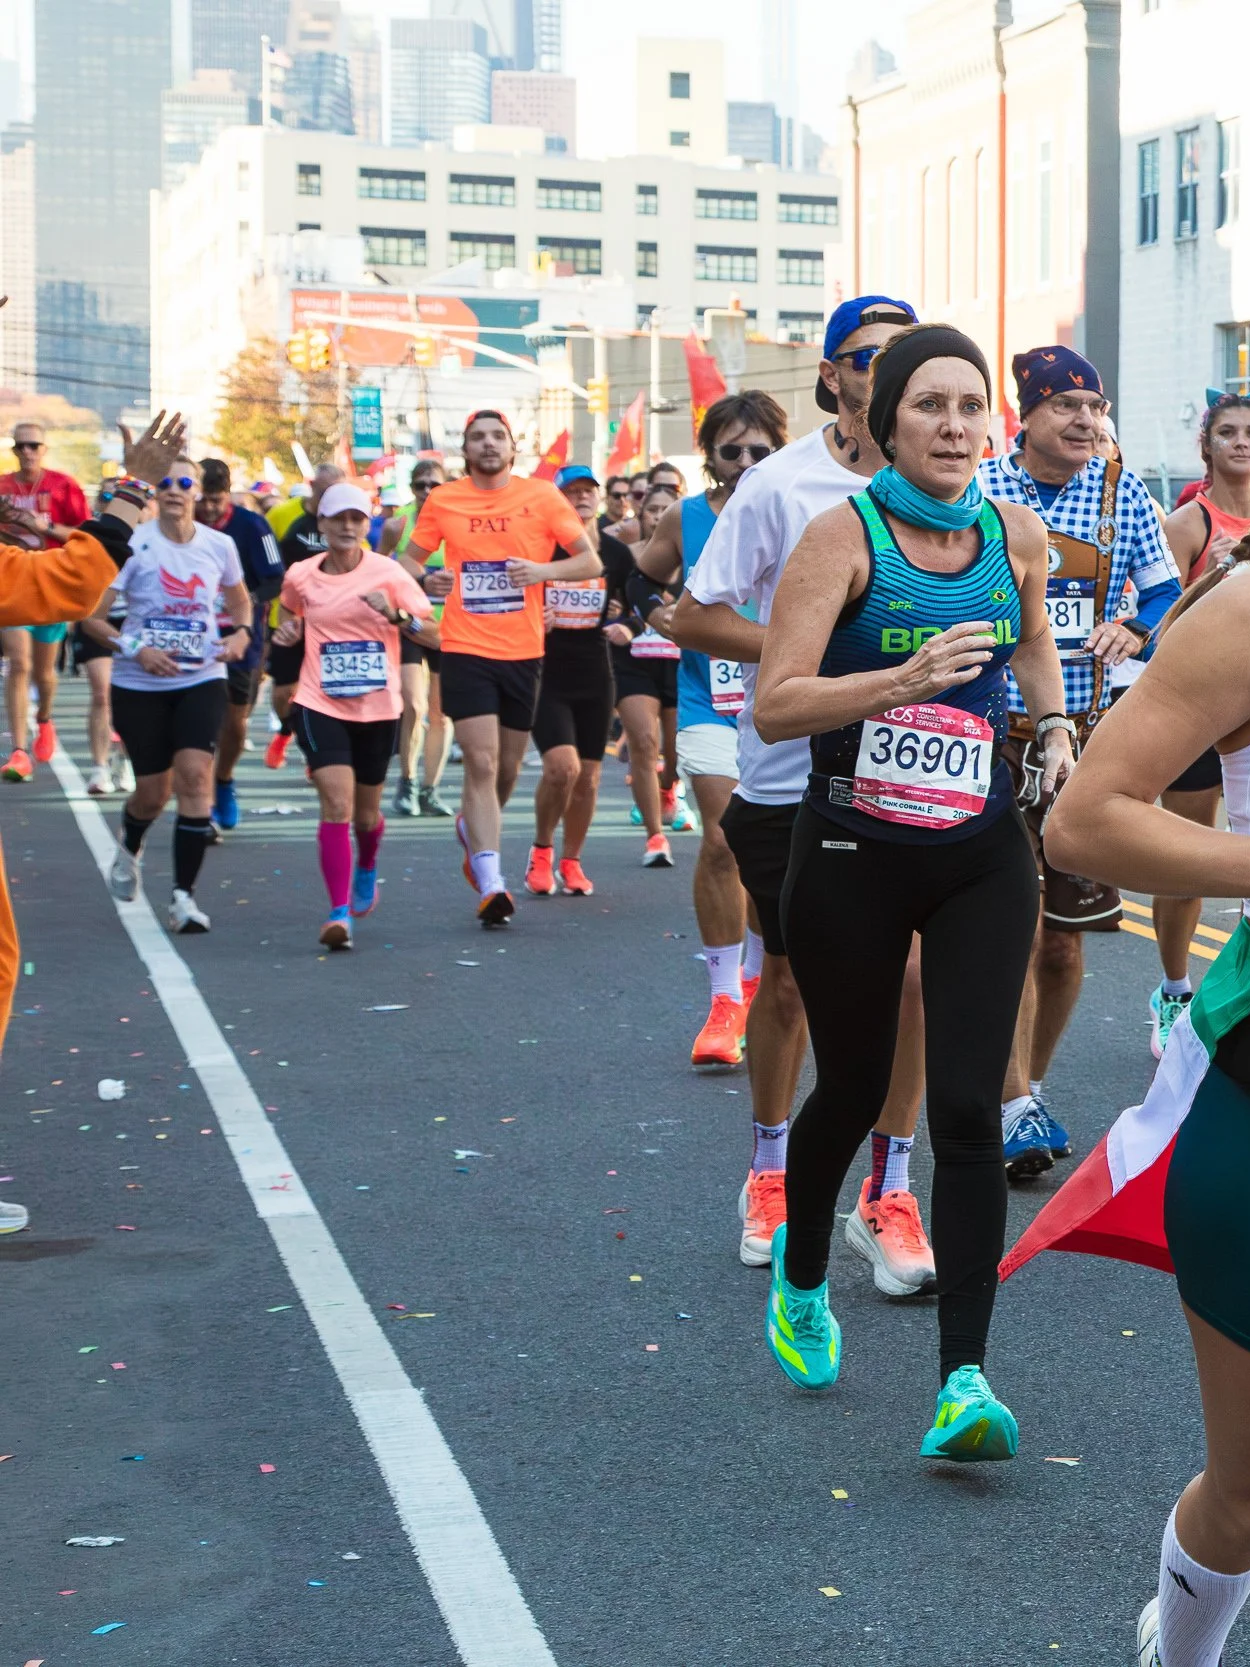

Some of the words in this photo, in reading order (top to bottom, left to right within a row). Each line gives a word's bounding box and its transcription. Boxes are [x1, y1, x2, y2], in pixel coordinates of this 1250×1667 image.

[468, 517, 512, 533] PAT
[550, 590, 601, 607] 37956
[881, 619, 1017, 653] BRIL
[323, 655, 384, 674] 33454
[918, 707, 936, 715] TATA
[915, 719, 942, 729] SERVICES
[916, 713, 956, 725] CONSULTANCY
[963, 727, 981, 735] TATA
[870, 727, 981, 780] 36901
[882, 800, 898, 808] PINK
[899, 803, 926, 812] CORRAL
[927, 805, 934, 814] E
